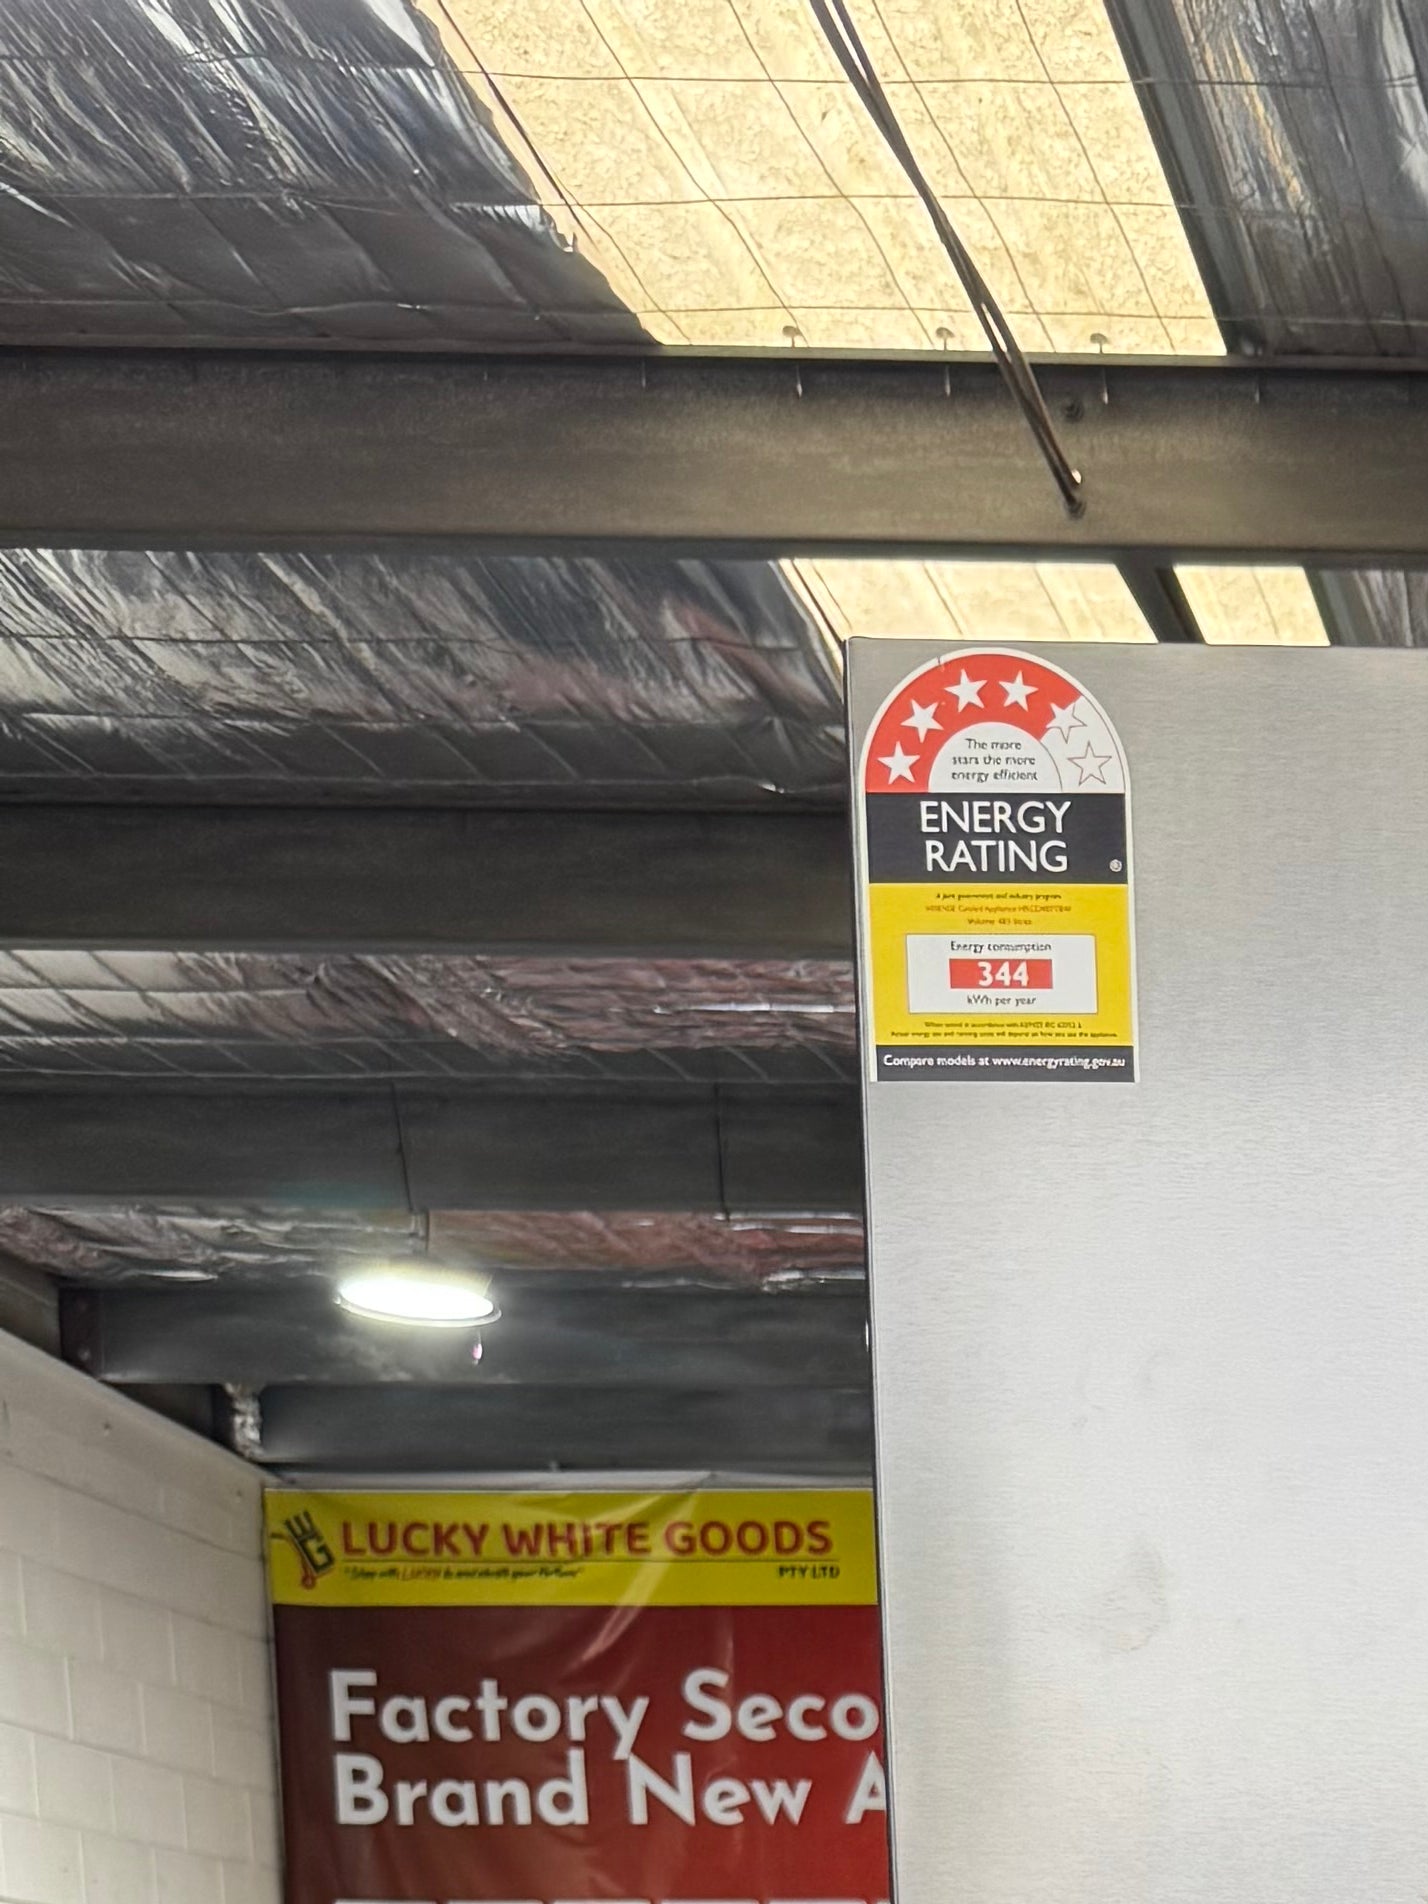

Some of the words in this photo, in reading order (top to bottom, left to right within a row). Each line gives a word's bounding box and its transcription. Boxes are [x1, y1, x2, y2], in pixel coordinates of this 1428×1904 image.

[965, 737, 988, 750] The
[990, 741, 1022, 751] more
[919, 800, 1071, 834] ENERGY
[925, 839, 1069, 873] RATING
[950, 940, 984, 954] Energy
[987, 942, 1052, 954] consumption
[977, 959, 1030, 988] 344
[966, 994, 993, 1005] kWh
[995, 996, 1011, 1007] per
[1015, 996, 1037, 1007] year
[883, 1054, 934, 1068] Compare
[936, 1054, 976, 1067] models
[978, 1055, 990, 1067] at
[341, 1519, 490, 1558] LUCKY
[503, 1519, 652, 1557] WHITE
[664, 1519, 834, 1556] GOODS
[779, 1566, 808, 1581] PTY
[329, 1668, 650, 1762] Factory
[334, 1748, 589, 1827] Brand
[628, 1752, 813, 1827] New
[845, 1751, 887, 1826] A
